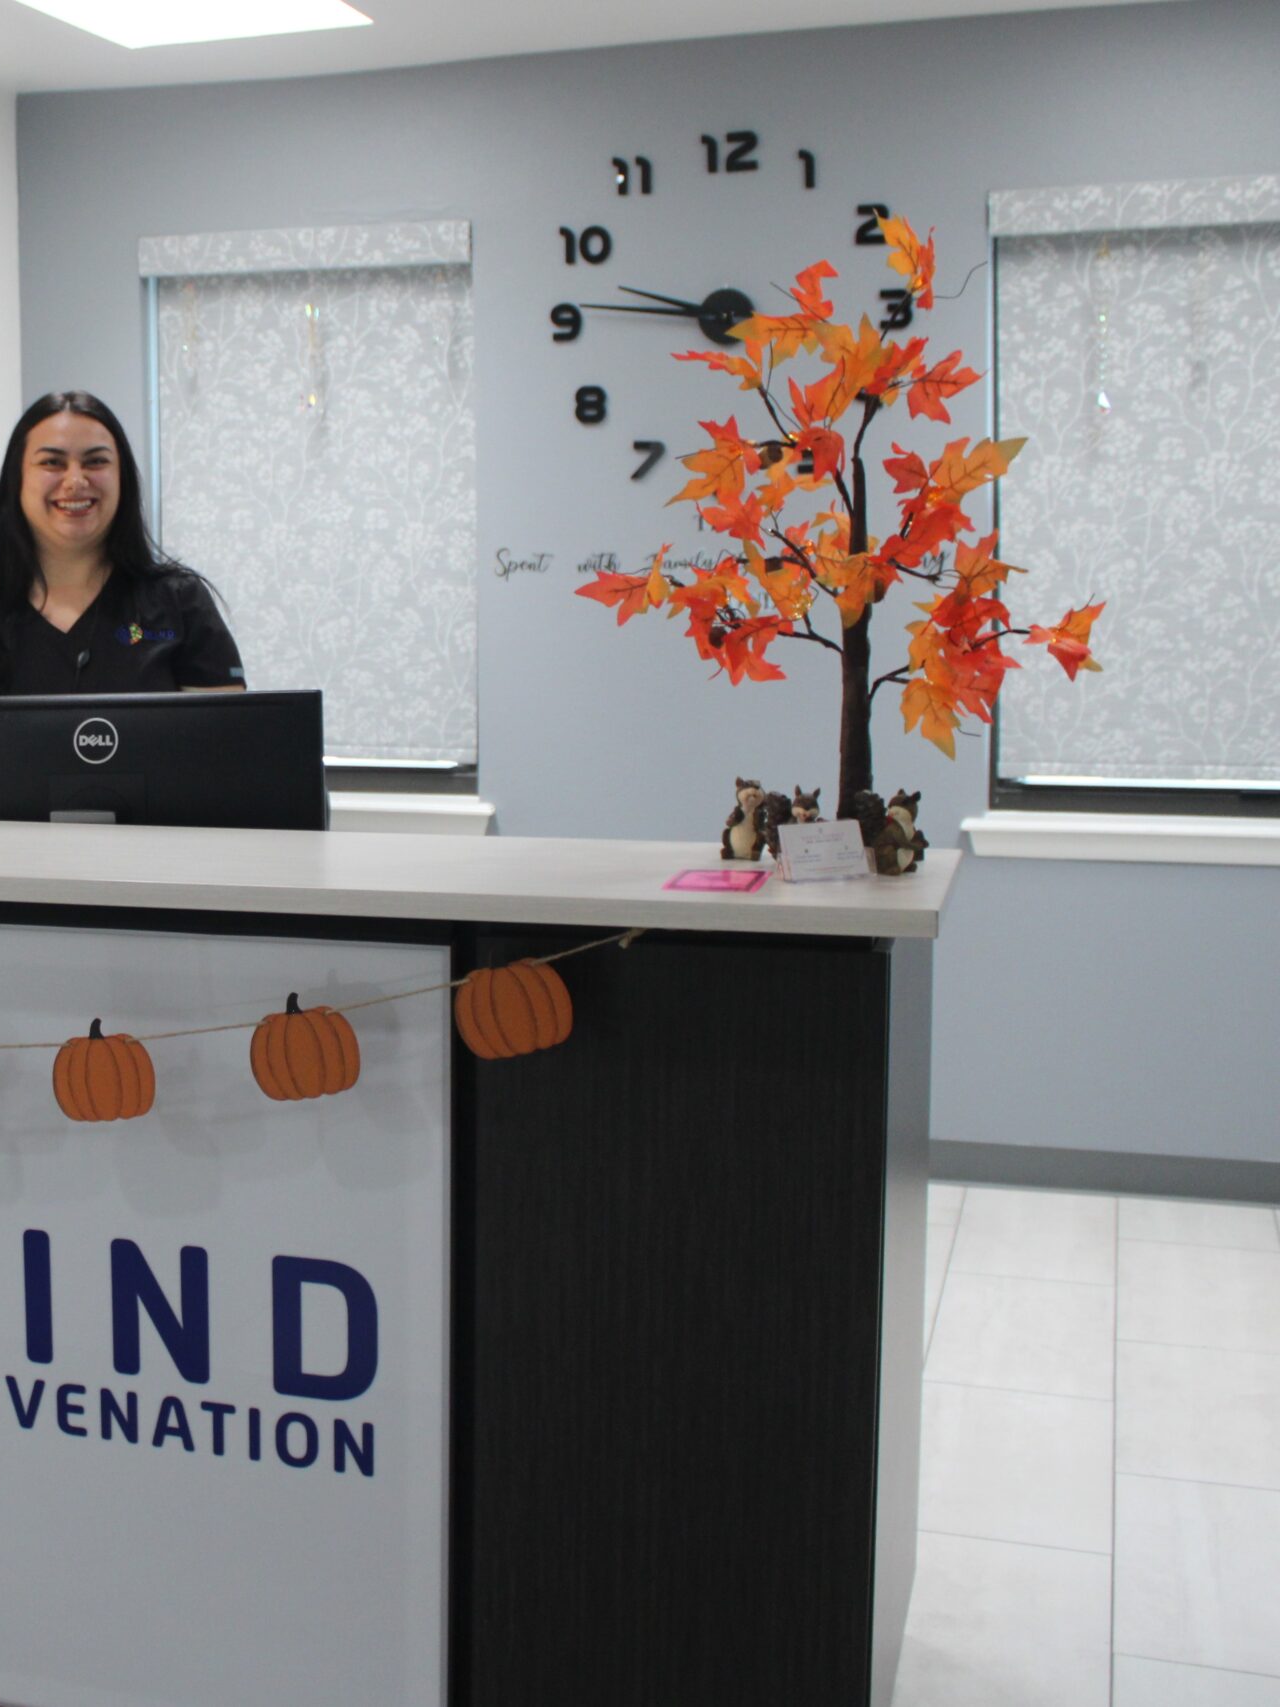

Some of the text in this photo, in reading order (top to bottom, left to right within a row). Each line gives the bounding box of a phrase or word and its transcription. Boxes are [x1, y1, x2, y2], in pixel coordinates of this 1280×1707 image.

[701, 131, 759, 173] 12
[798, 149, 816, 188] 1
[612, 155, 653, 195] 11
[855, 203, 889, 245] 2
[559, 225, 612, 265] 10
[550, 303, 582, 342] 9
[879, 289, 913, 330] 3
[575, 385, 607, 425] 8
[631, 440, 666, 480] 7
[494, 547, 554, 584] Spent
[577, 551, 621, 574] with
[78, 734, 114, 747] DELL
